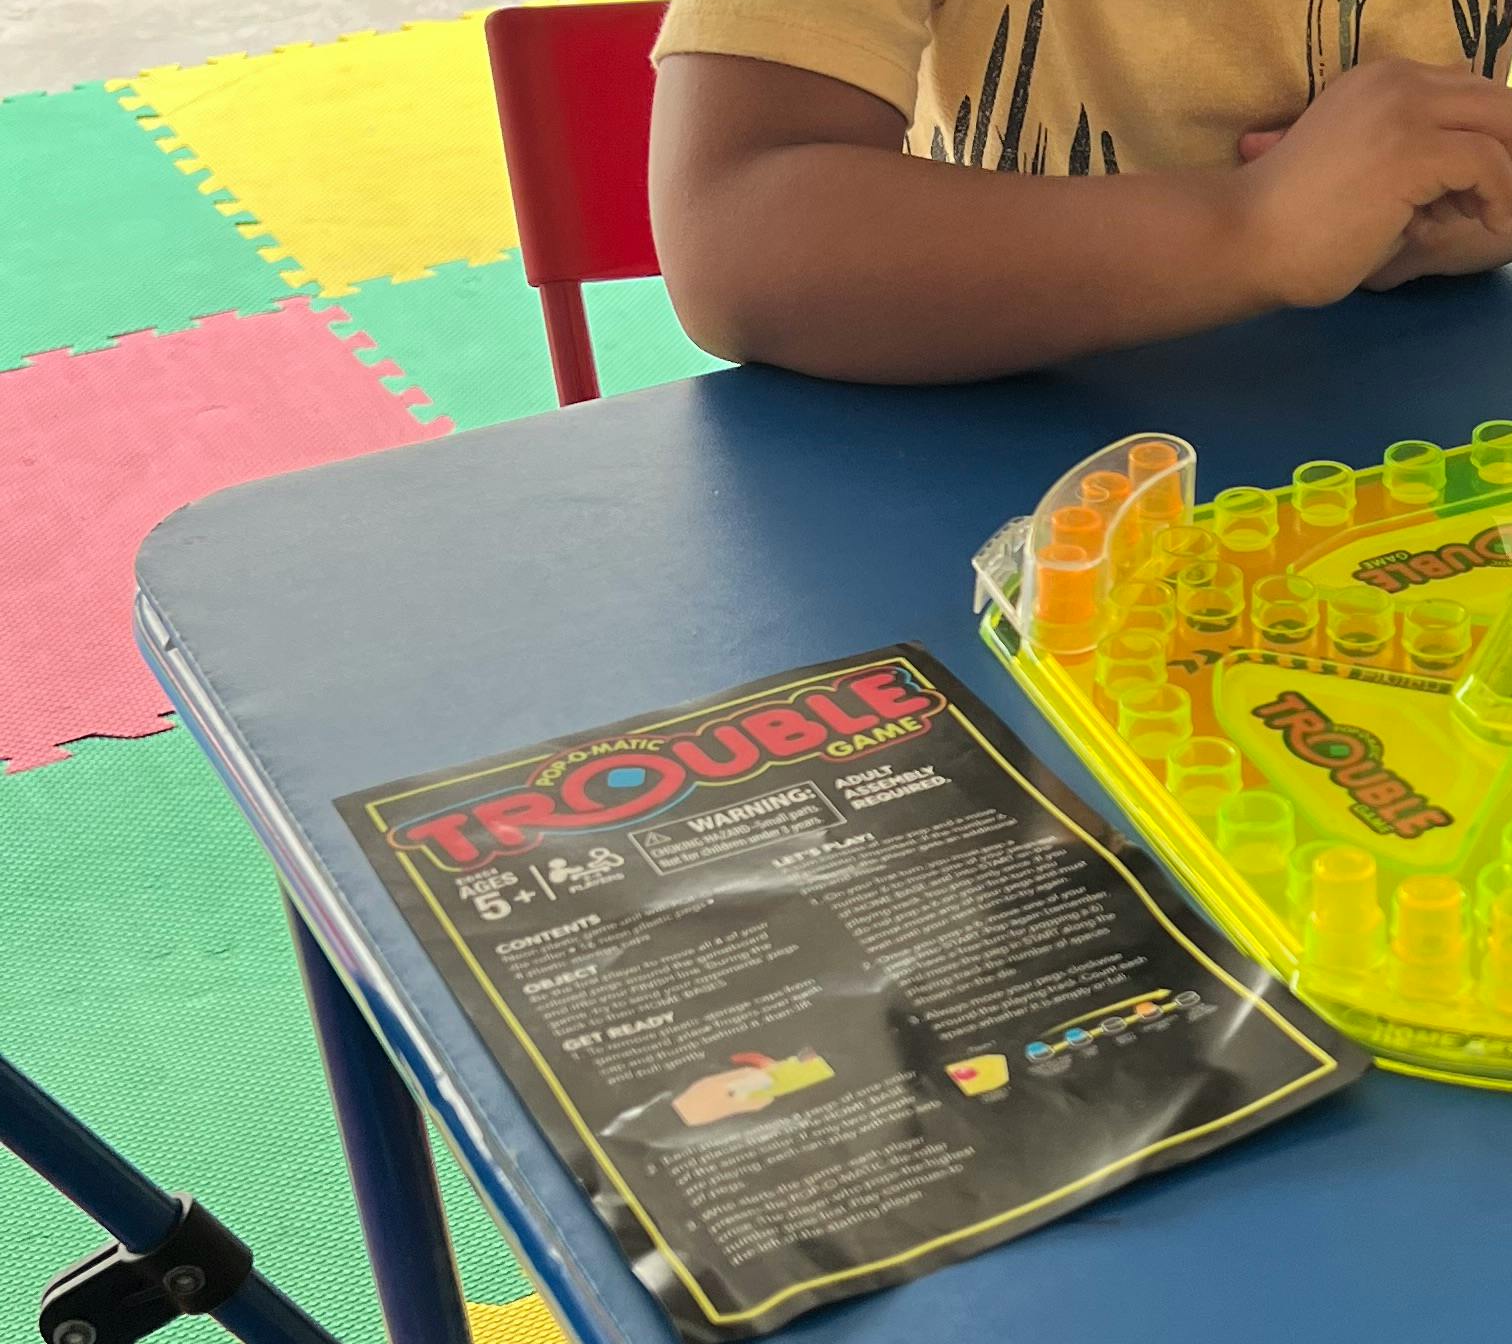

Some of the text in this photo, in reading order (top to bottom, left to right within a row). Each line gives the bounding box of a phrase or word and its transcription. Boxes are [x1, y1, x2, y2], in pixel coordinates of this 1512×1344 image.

[826, 716, 922, 756] GAME
[405, 672, 933, 864] TROUBLE
[535, 739, 665, 787] POP-O-MATIC
[834, 764, 894, 790] ADULT
[843, 765, 936, 800] ASSEMBLY
[1252, 692, 1453, 839] TROUBLE
[686, 788, 817, 833] WARNING:
[850, 775, 953, 811] REQUIRED.
[459, 870, 519, 900] AGES
[495, 913, 602, 955] CONTENTS
[523, 964, 598, 995] OBJECT
[562, 1031, 604, 1053] GET
[606, 1010, 675, 1043] READY
